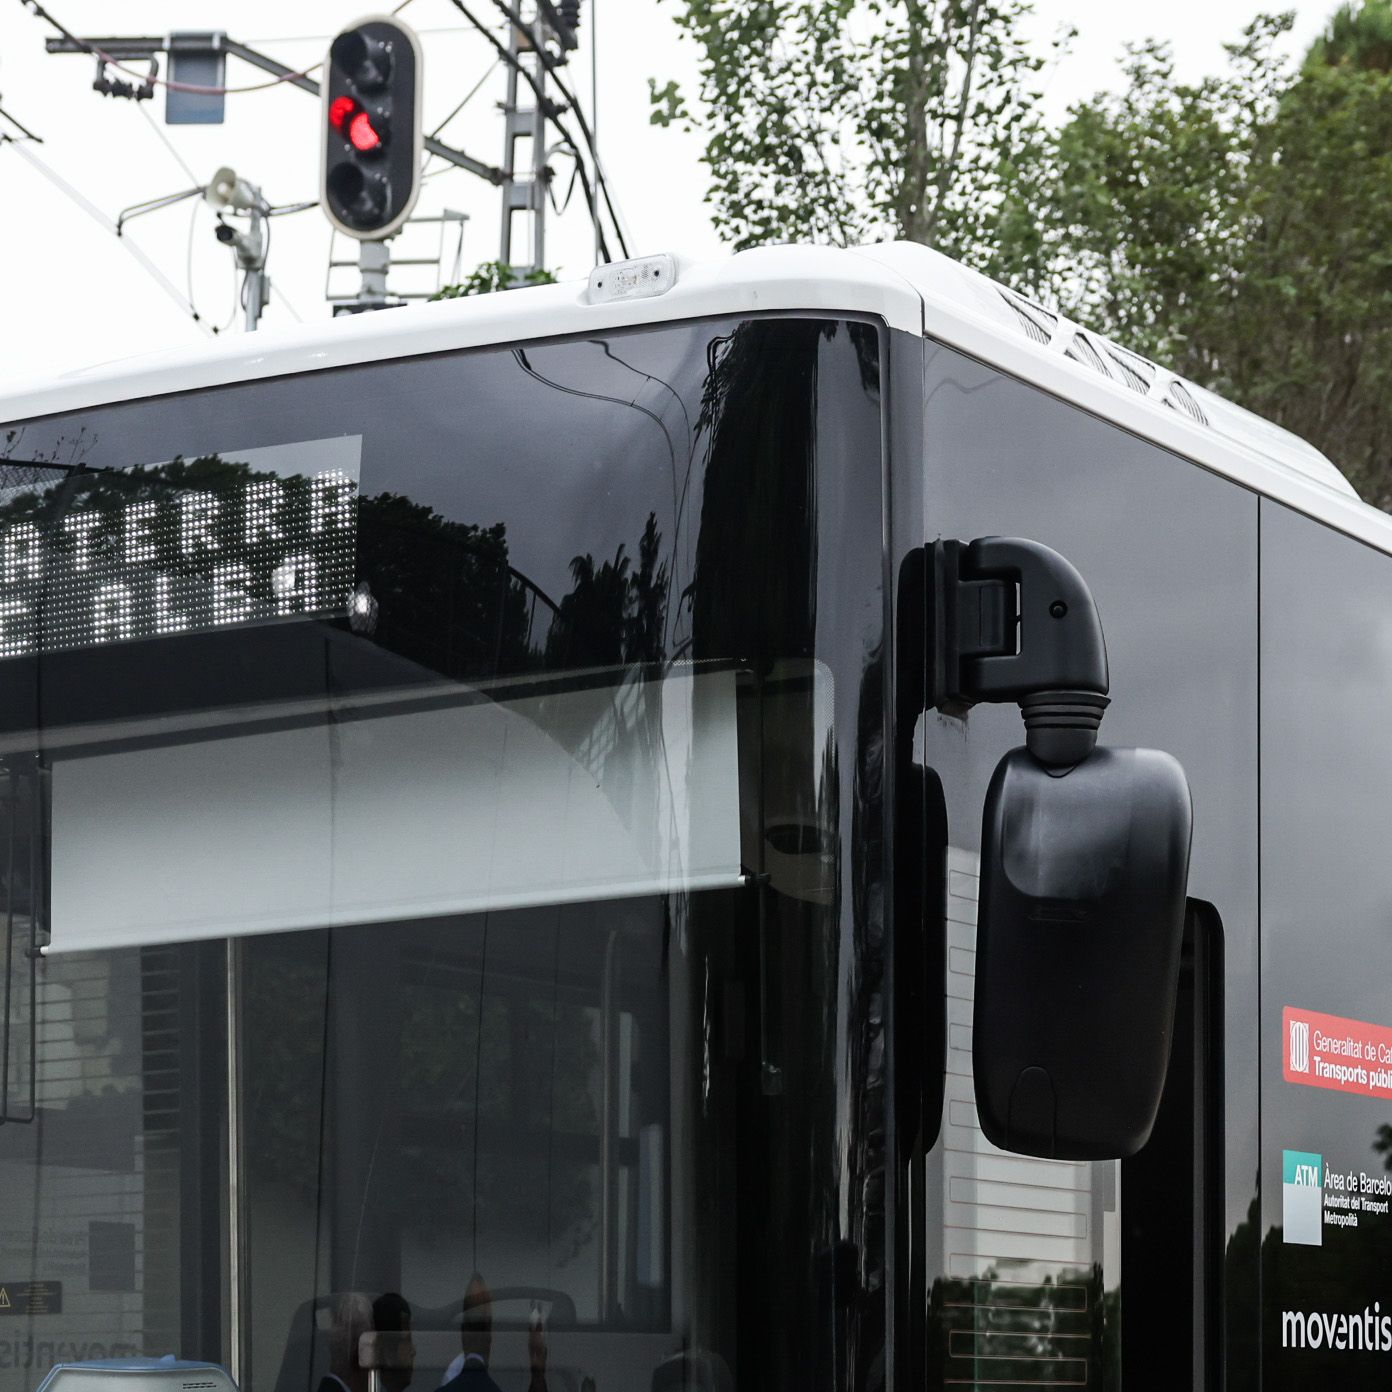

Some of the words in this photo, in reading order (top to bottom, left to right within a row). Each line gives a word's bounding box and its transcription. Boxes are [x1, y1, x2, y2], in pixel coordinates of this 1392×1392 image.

[93, 552, 318, 643] ALBA
[1313, 1030, 1363, 1060] Generalitat
[1364, 1042, 1377, 1061] de
[1313, 1056, 1368, 1084] Transports
[1294, 1164, 1319, 1187] ATM
[1324, 1163, 1345, 1191] Àrea
[1346, 1170, 1358, 1192] de
[1324, 1193, 1350, 1209] Autoritat
[1350, 1196, 1360, 1210] del
[1361, 1197, 1389, 1215] Transport
[1282, 1301, 1392, 1351] moventis
